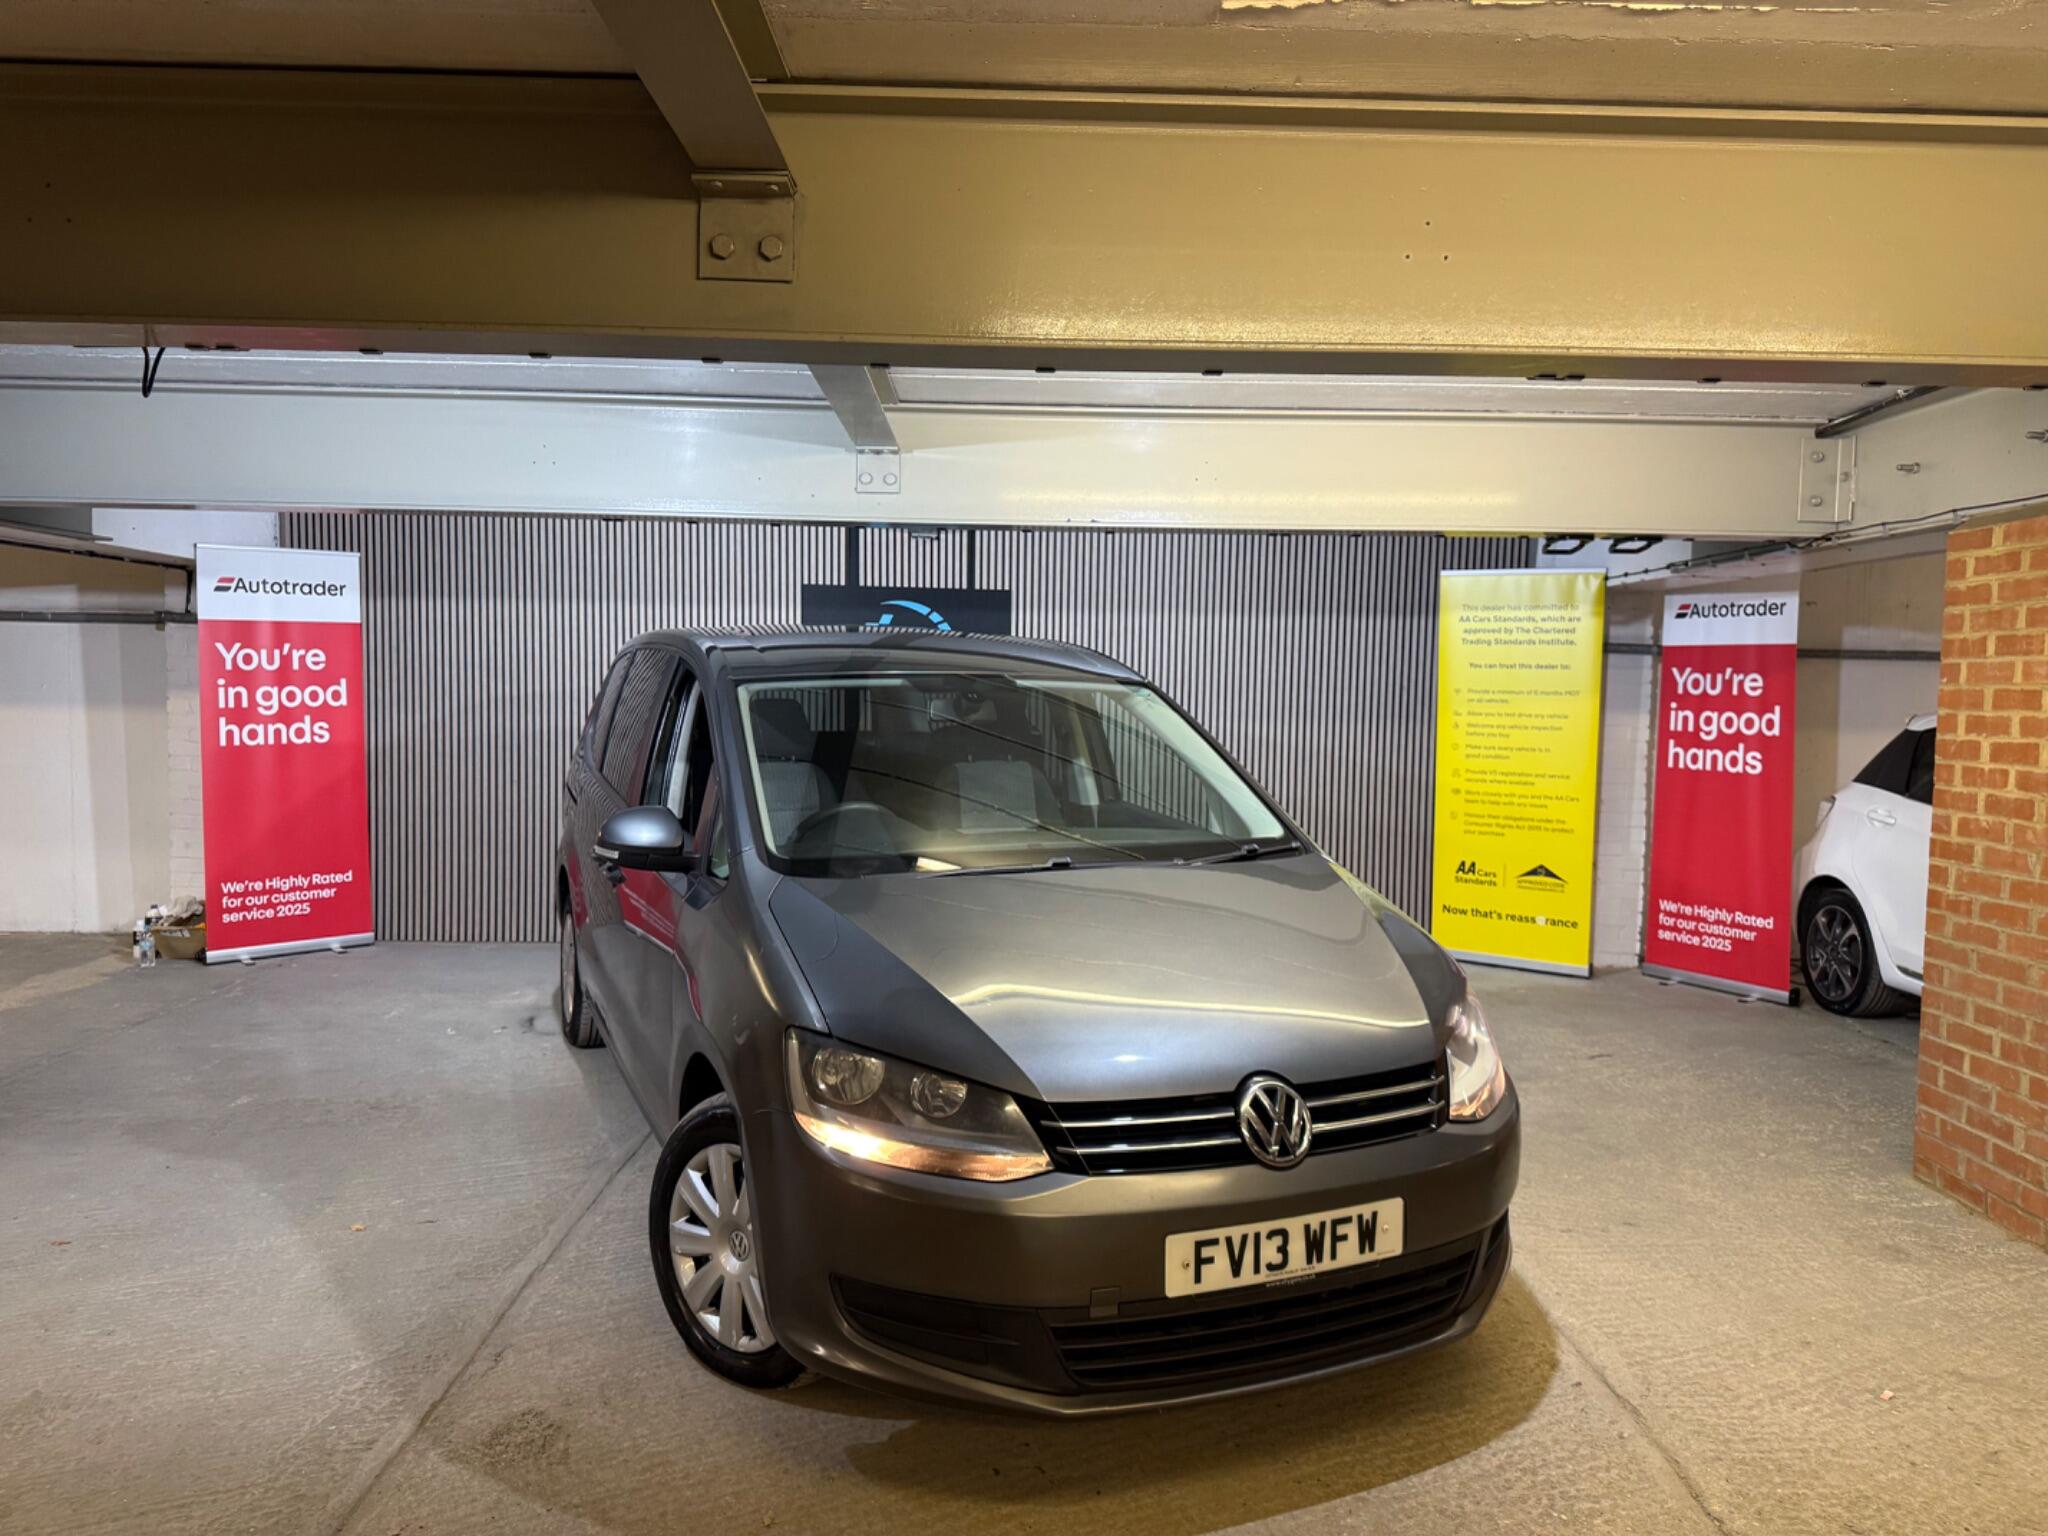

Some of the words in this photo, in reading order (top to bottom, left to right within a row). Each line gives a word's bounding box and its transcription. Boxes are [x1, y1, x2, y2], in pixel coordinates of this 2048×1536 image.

[233, 577, 346, 596] Autotrader
[1458, 615, 1470, 623] AA
[1472, 615, 1491, 623] Cars
[1689, 600, 1787, 619] Autotrader
[1461, 638, 1492, 647] Trading
[1494, 638, 1536, 646] Standards
[1463, 627, 1501, 635] approved
[1504, 627, 1513, 635] by
[214, 642, 327, 671] You're
[1672, 667, 1763, 697] You're
[217, 678, 248, 708] in
[255, 678, 348, 716] good
[219, 714, 331, 747] hands
[1669, 702, 1694, 732] in
[1699, 705, 1781, 741] good
[1667, 739, 1763, 775] hands
[1456, 860, 1476, 875] AA
[1477, 869, 1497, 878] Cars
[221, 880, 263, 894] We're
[265, 875, 310, 891] Highly
[312, 870, 353, 885] Rated
[1455, 876, 1497, 887] Standards
[222, 896, 243, 908] for
[245, 894, 270, 906] our
[271, 888, 337, 904] customer
[222, 907, 275, 923] service
[276, 902, 311, 918] 2025
[1442, 904, 1468, 916] Now
[1471, 907, 1502, 920] that's
[1505, 914, 1579, 929] reassrance
[1658, 899, 1693, 915] We're
[1694, 904, 1733, 924] Highly
[1735, 911, 1774, 929] Rated
[1658, 913, 1675, 926] for
[1676, 918, 1697, 930] our
[1698, 921, 1757, 941] customer
[1657, 929, 1700, 946] service
[1701, 935, 1732, 952] 2025
[1194, 1227, 1290, 1285] FV13
[1303, 1210, 1378, 1266] WFW
